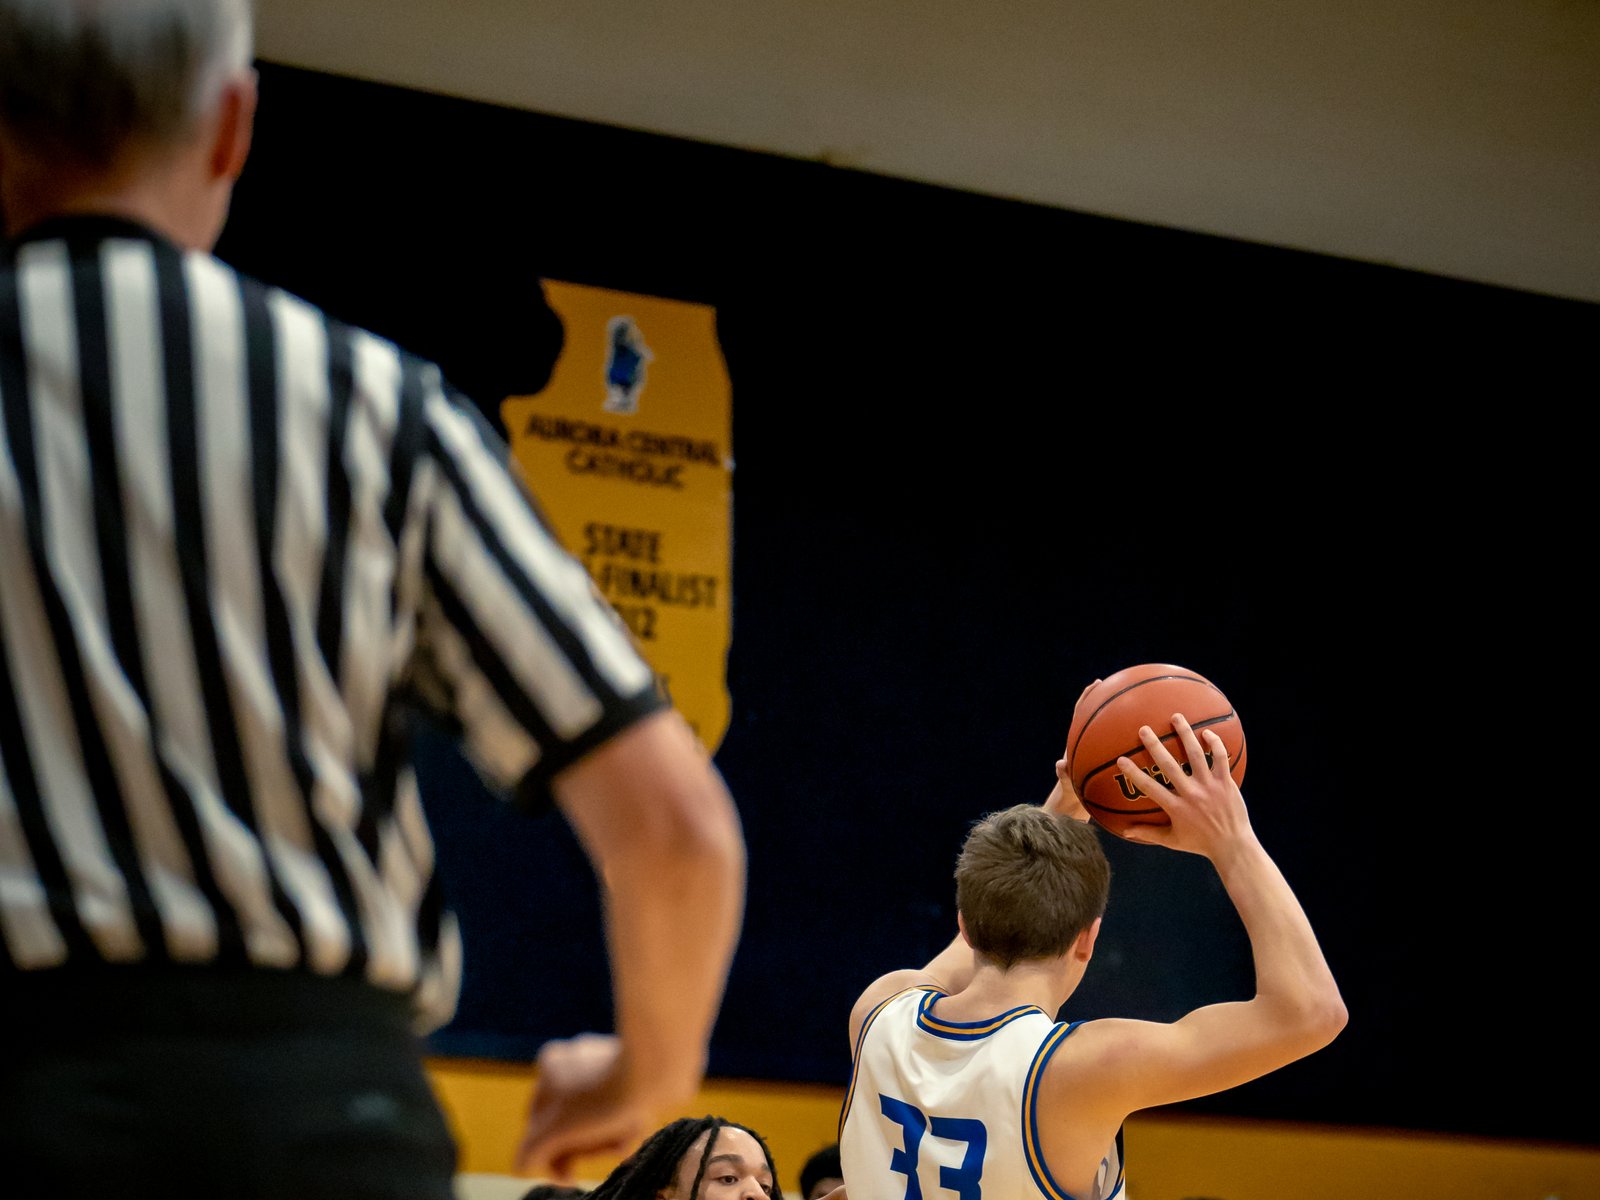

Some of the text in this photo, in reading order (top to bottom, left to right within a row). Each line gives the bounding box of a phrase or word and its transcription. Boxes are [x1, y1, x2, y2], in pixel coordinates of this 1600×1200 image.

[526, 414, 719, 467] AURORA CENTRAL
[566, 448, 684, 490] CATHOLIC
[584, 521, 661, 565] STATE
